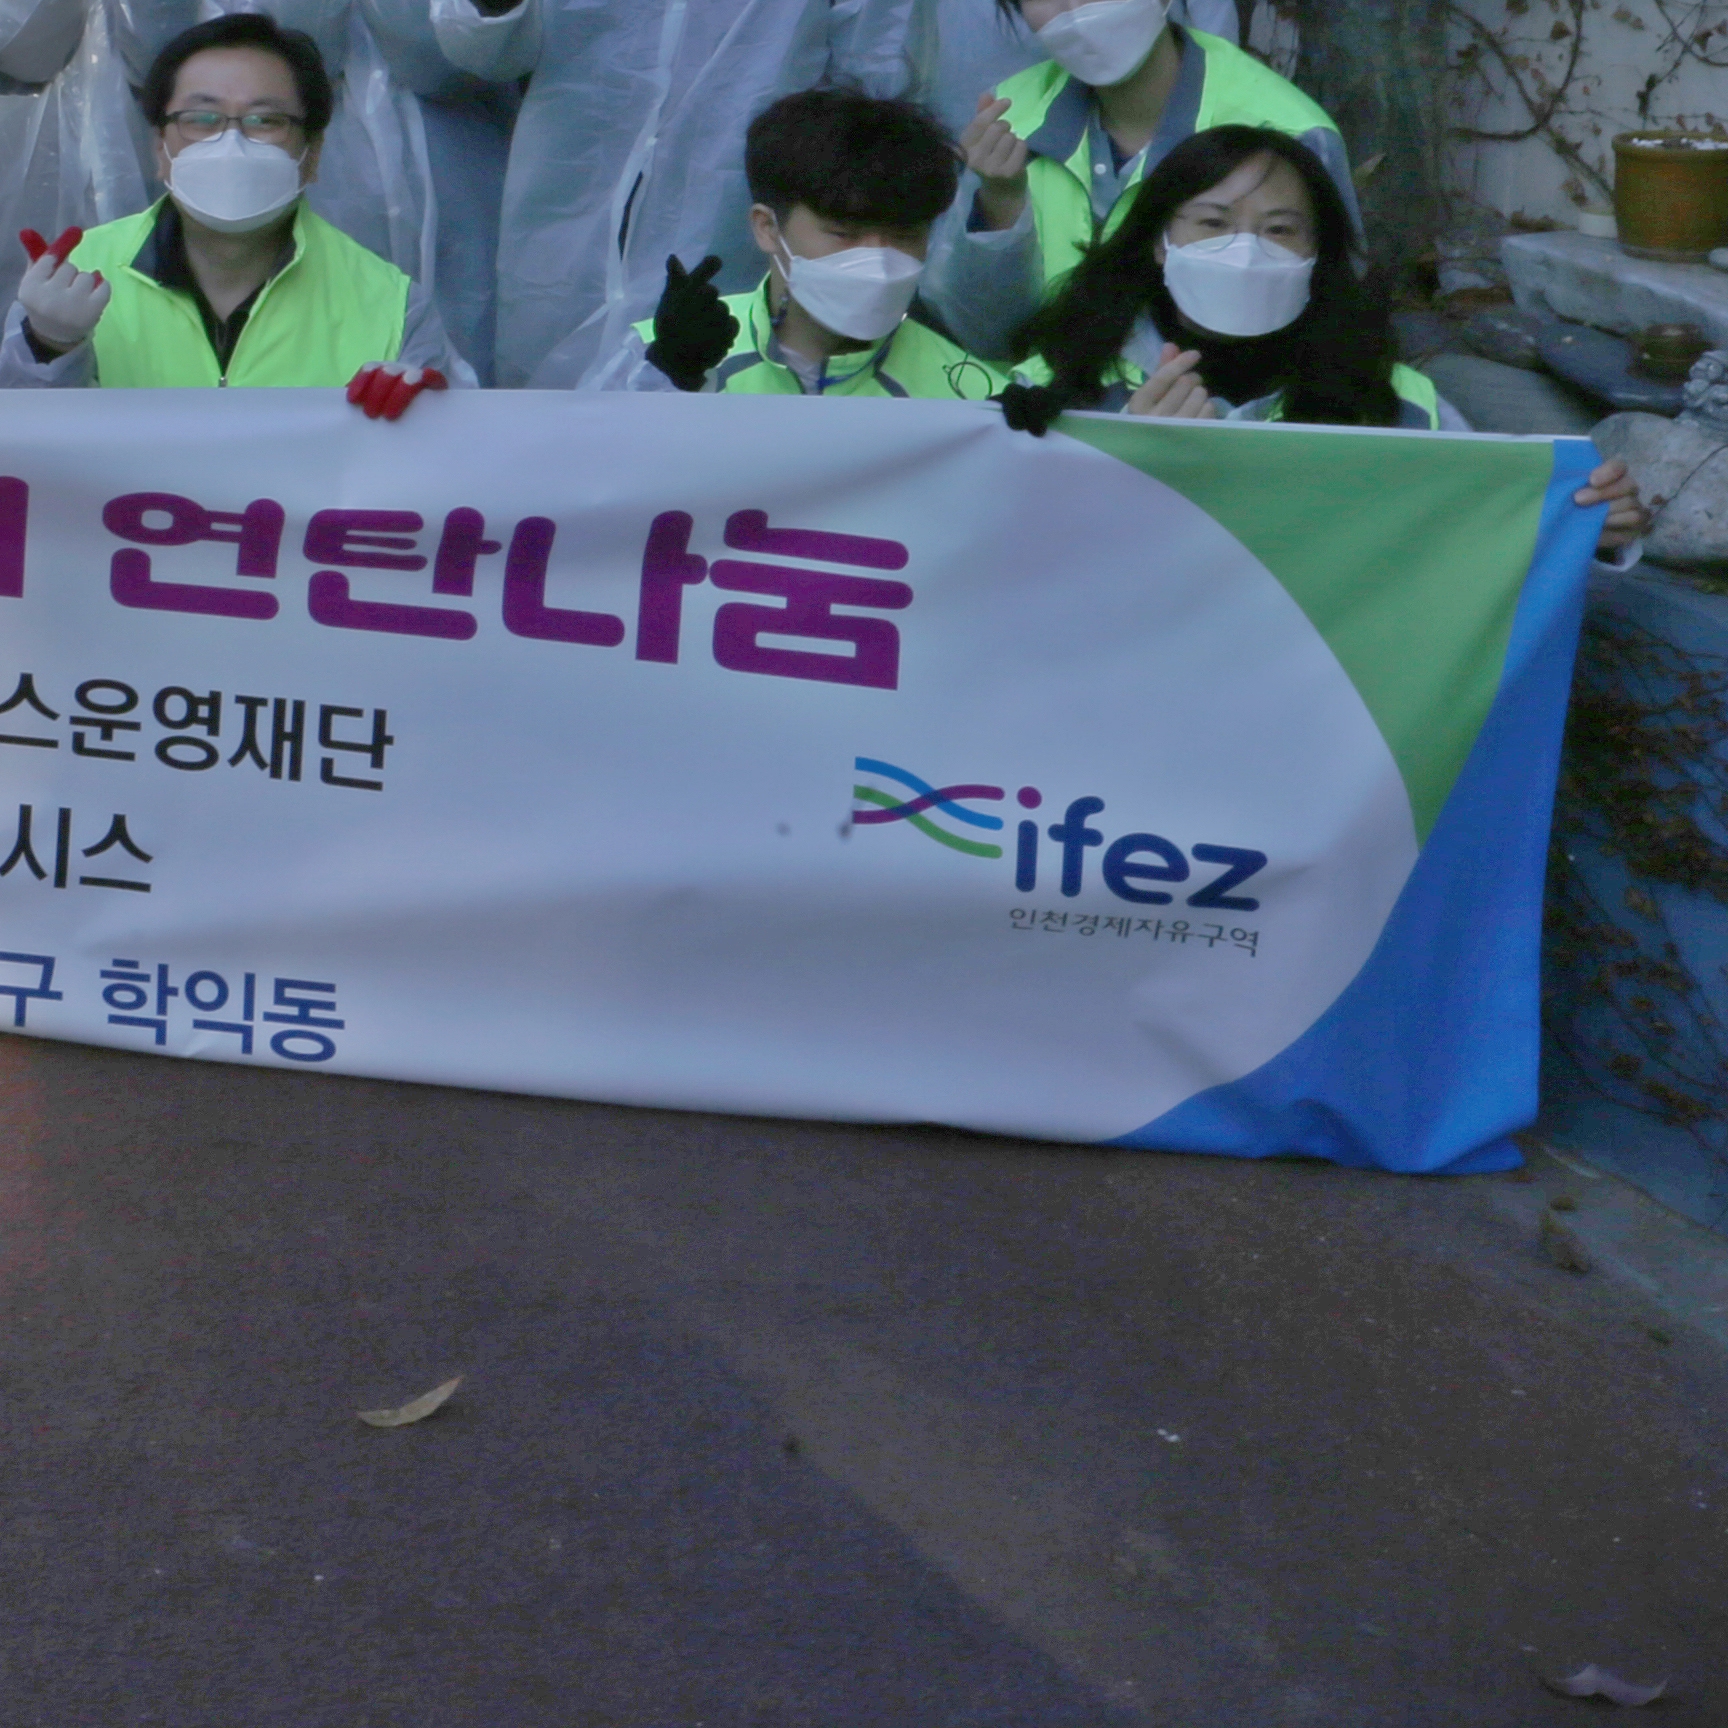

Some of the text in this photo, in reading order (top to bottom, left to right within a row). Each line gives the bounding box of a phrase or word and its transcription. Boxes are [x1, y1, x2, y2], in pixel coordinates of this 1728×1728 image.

[101, 491, 915, 691] 연탄나눔
[1015, 785, 1268, 913] ifez
[1009, 907, 1260, 959] 인천경제자유구역
[98, 957, 346, 1063] 학익동
